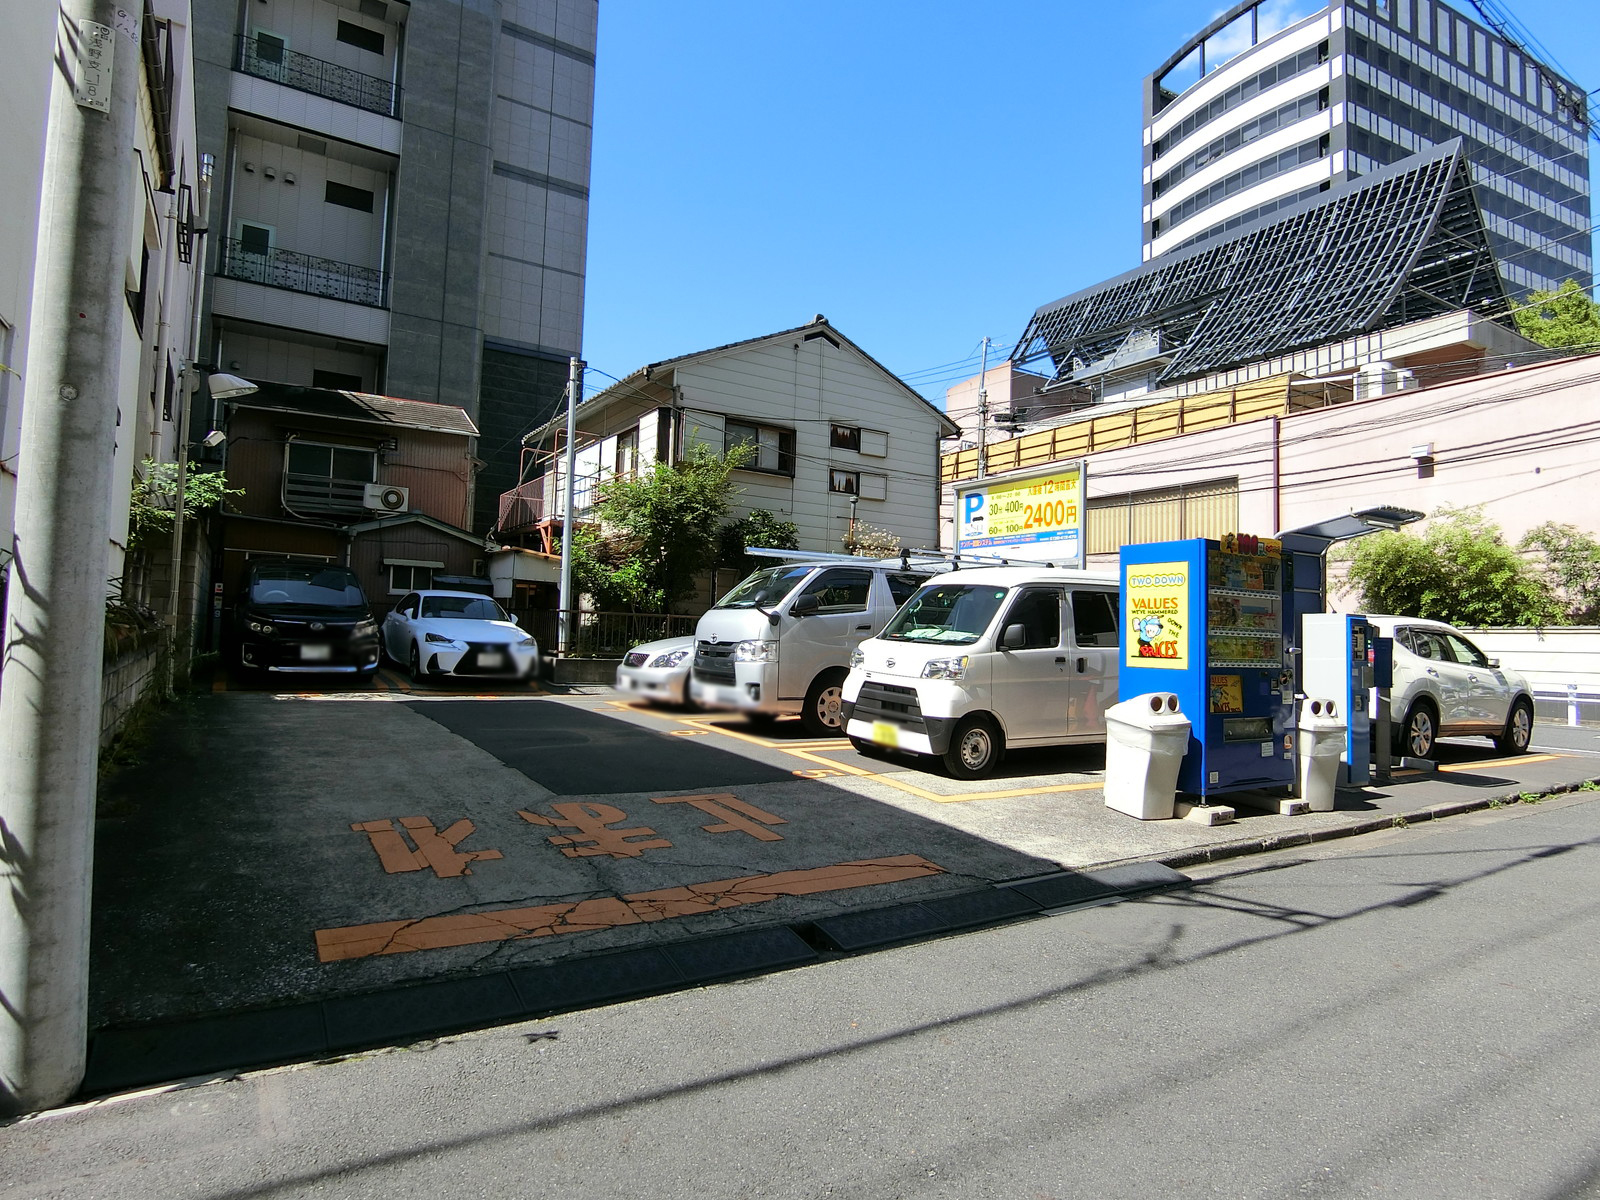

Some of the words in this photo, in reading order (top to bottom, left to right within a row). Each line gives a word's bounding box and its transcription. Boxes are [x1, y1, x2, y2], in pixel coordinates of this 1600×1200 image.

[964, 492, 985, 524] P
[1023, 499, 1077, 530] 2400円
[1131, 576, 1152, 586] TWO
[1154, 575, 1184, 585] DOWN
[1131, 597, 1179, 610] VALUES
[1166, 617, 1183, 630] DOWN
[1139, 639, 1178, 658] PRICES
[349, 792, 790, 879] 止まれ
